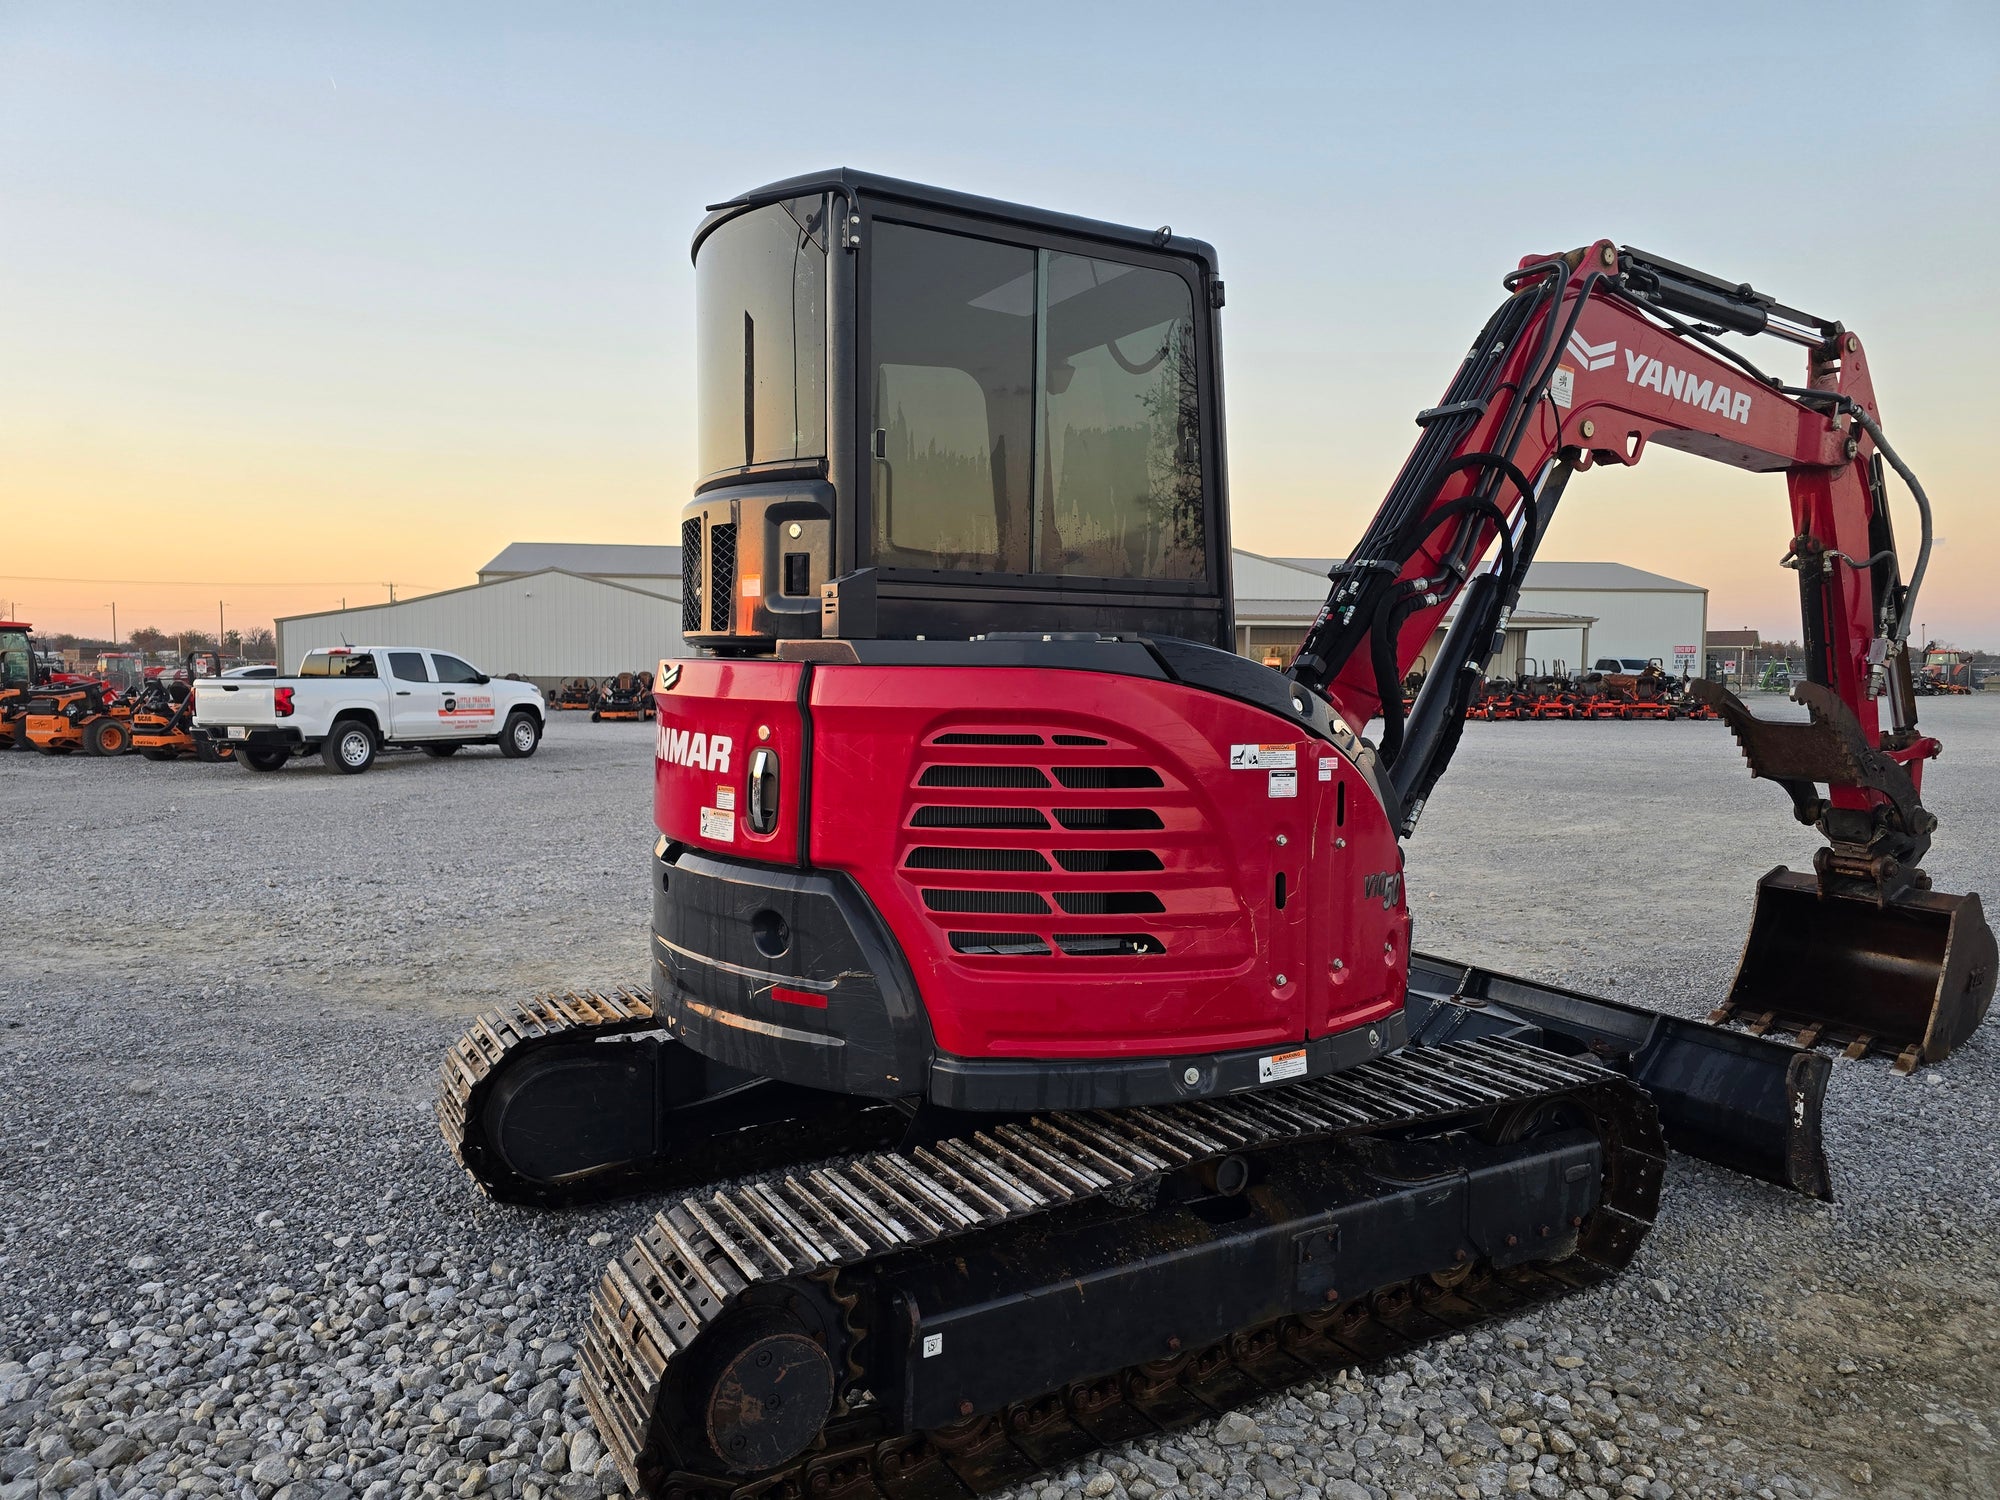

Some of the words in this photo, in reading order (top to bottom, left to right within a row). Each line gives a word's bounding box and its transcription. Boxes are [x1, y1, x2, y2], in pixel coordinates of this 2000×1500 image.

[1624, 348, 1752, 425] YANMAR
[655, 725, 733, 774] ANMAR
[1283, 1052, 1301, 1060] WARNING
